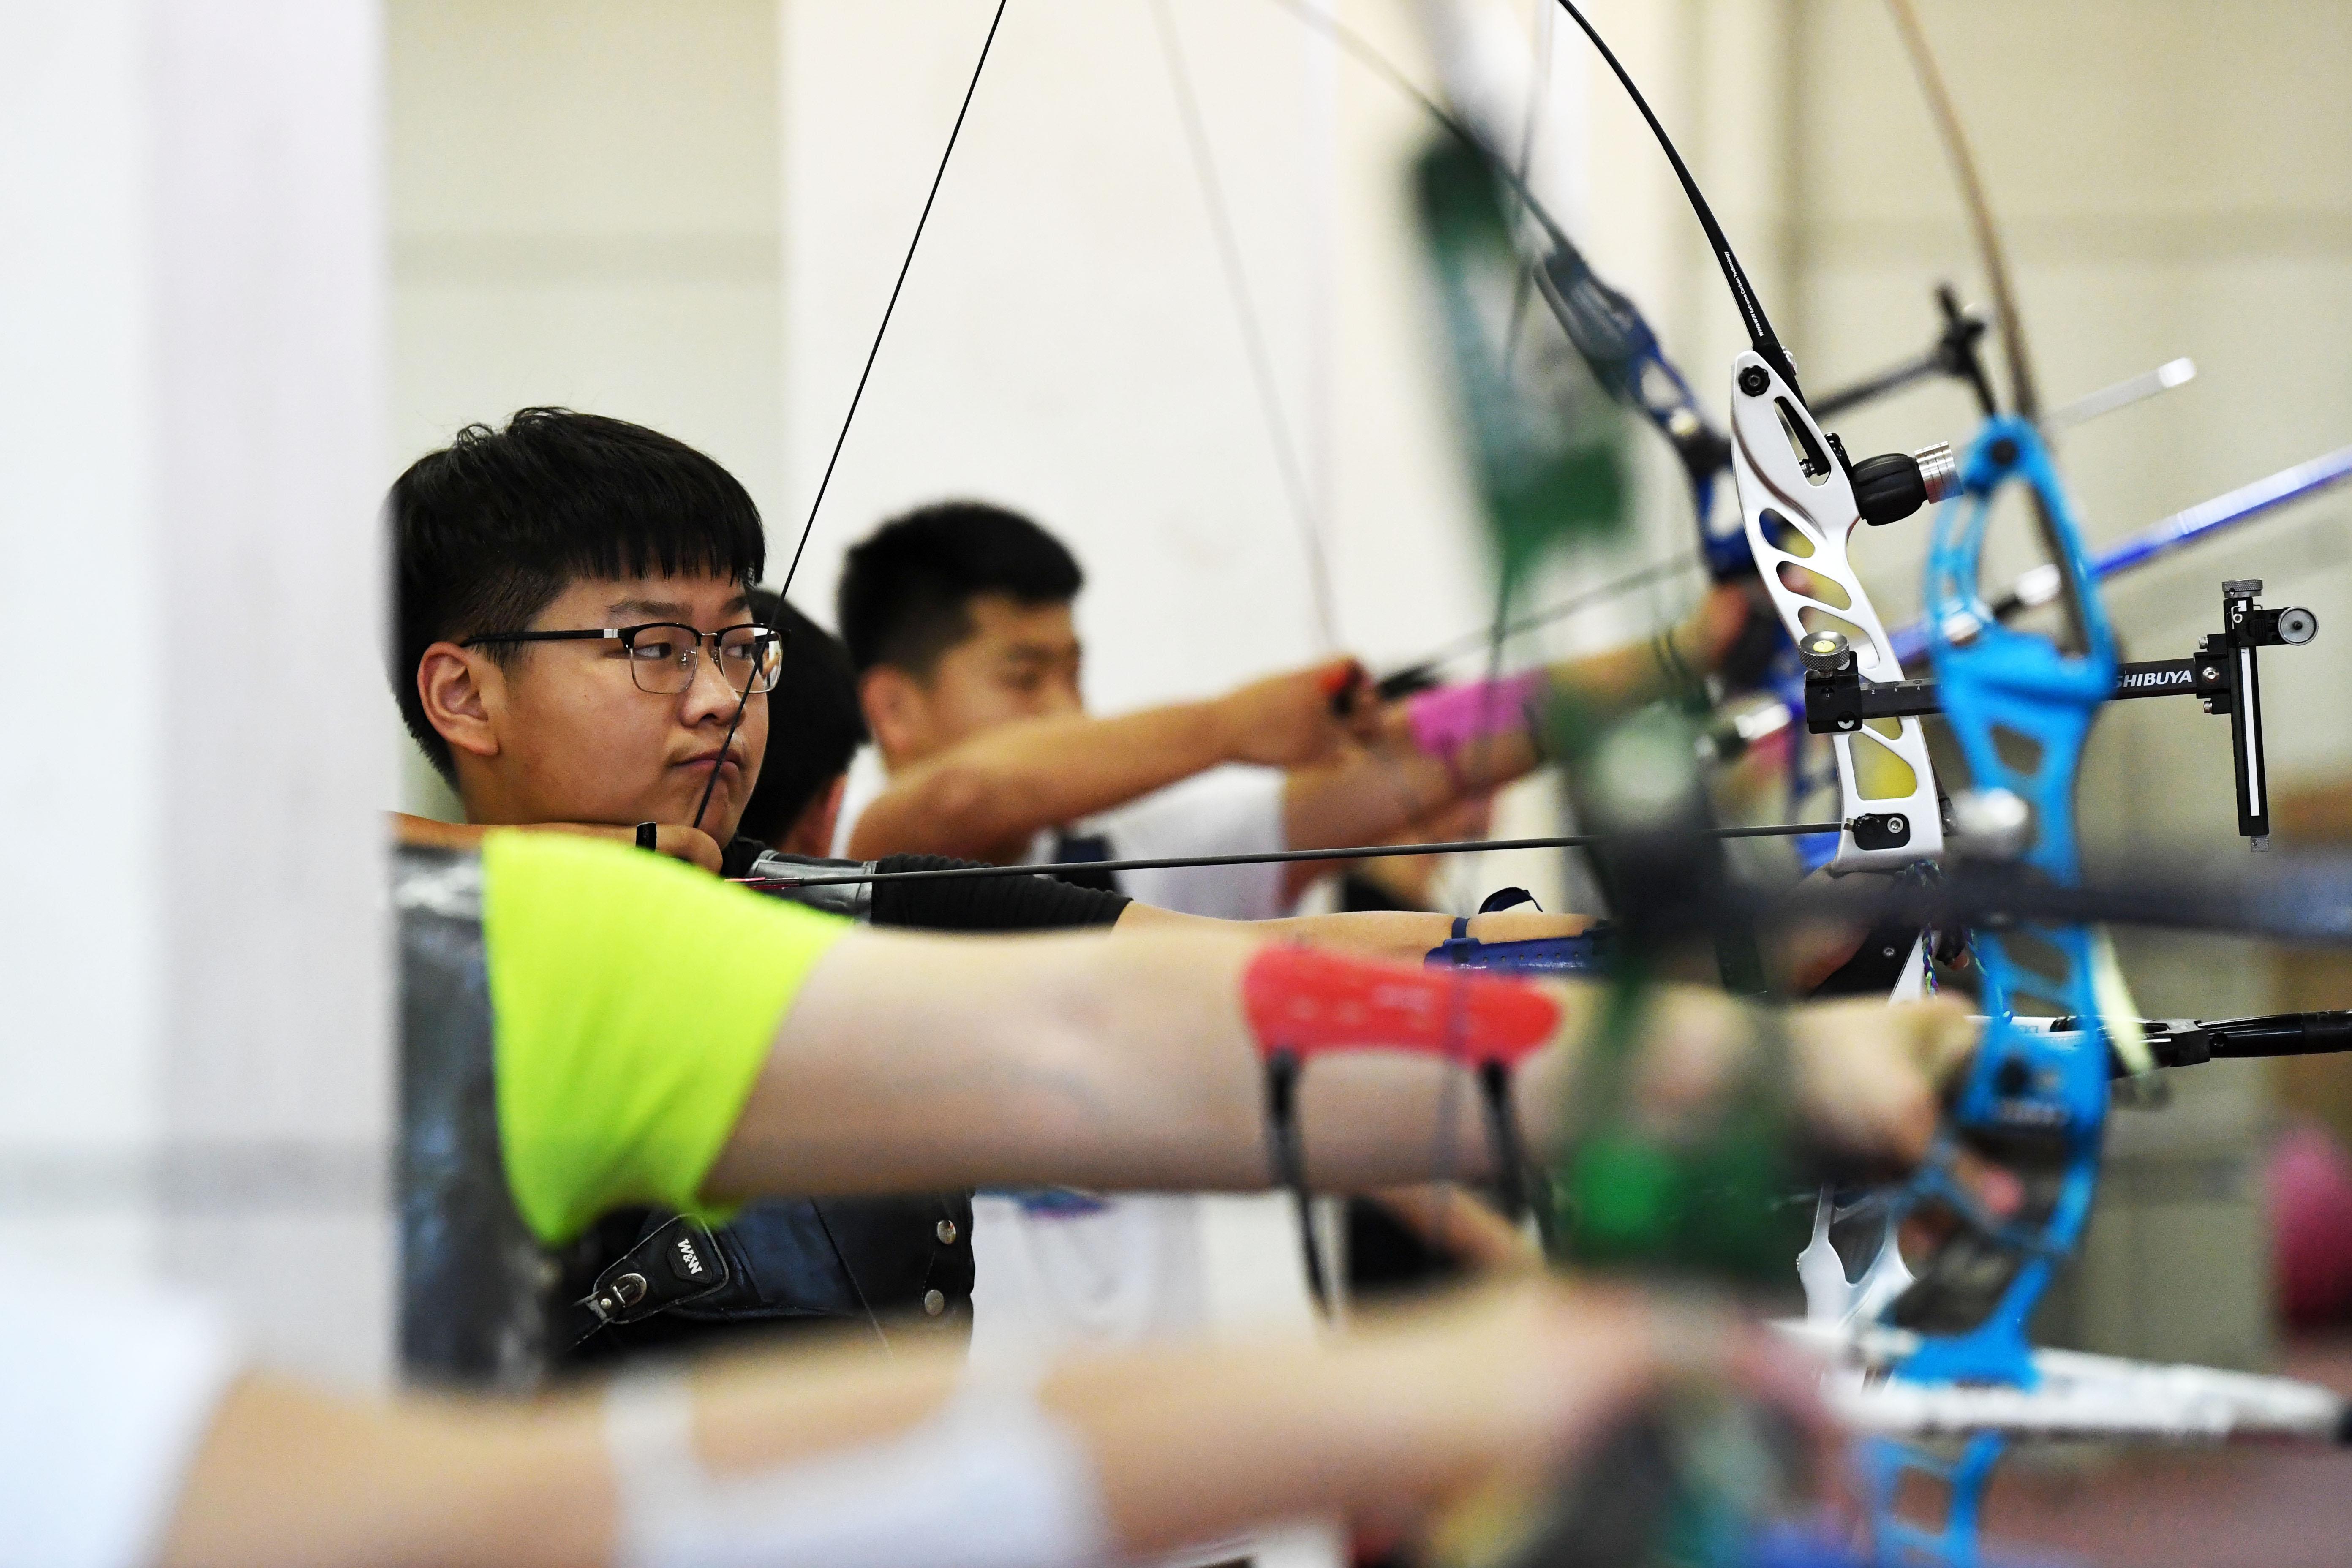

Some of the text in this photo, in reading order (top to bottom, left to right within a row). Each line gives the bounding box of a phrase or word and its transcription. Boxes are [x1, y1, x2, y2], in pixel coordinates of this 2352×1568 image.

[1724, 251, 1764, 337] WIN&WIN Extreme Carbon Technology
[678, 1239, 702, 1274] W&W
